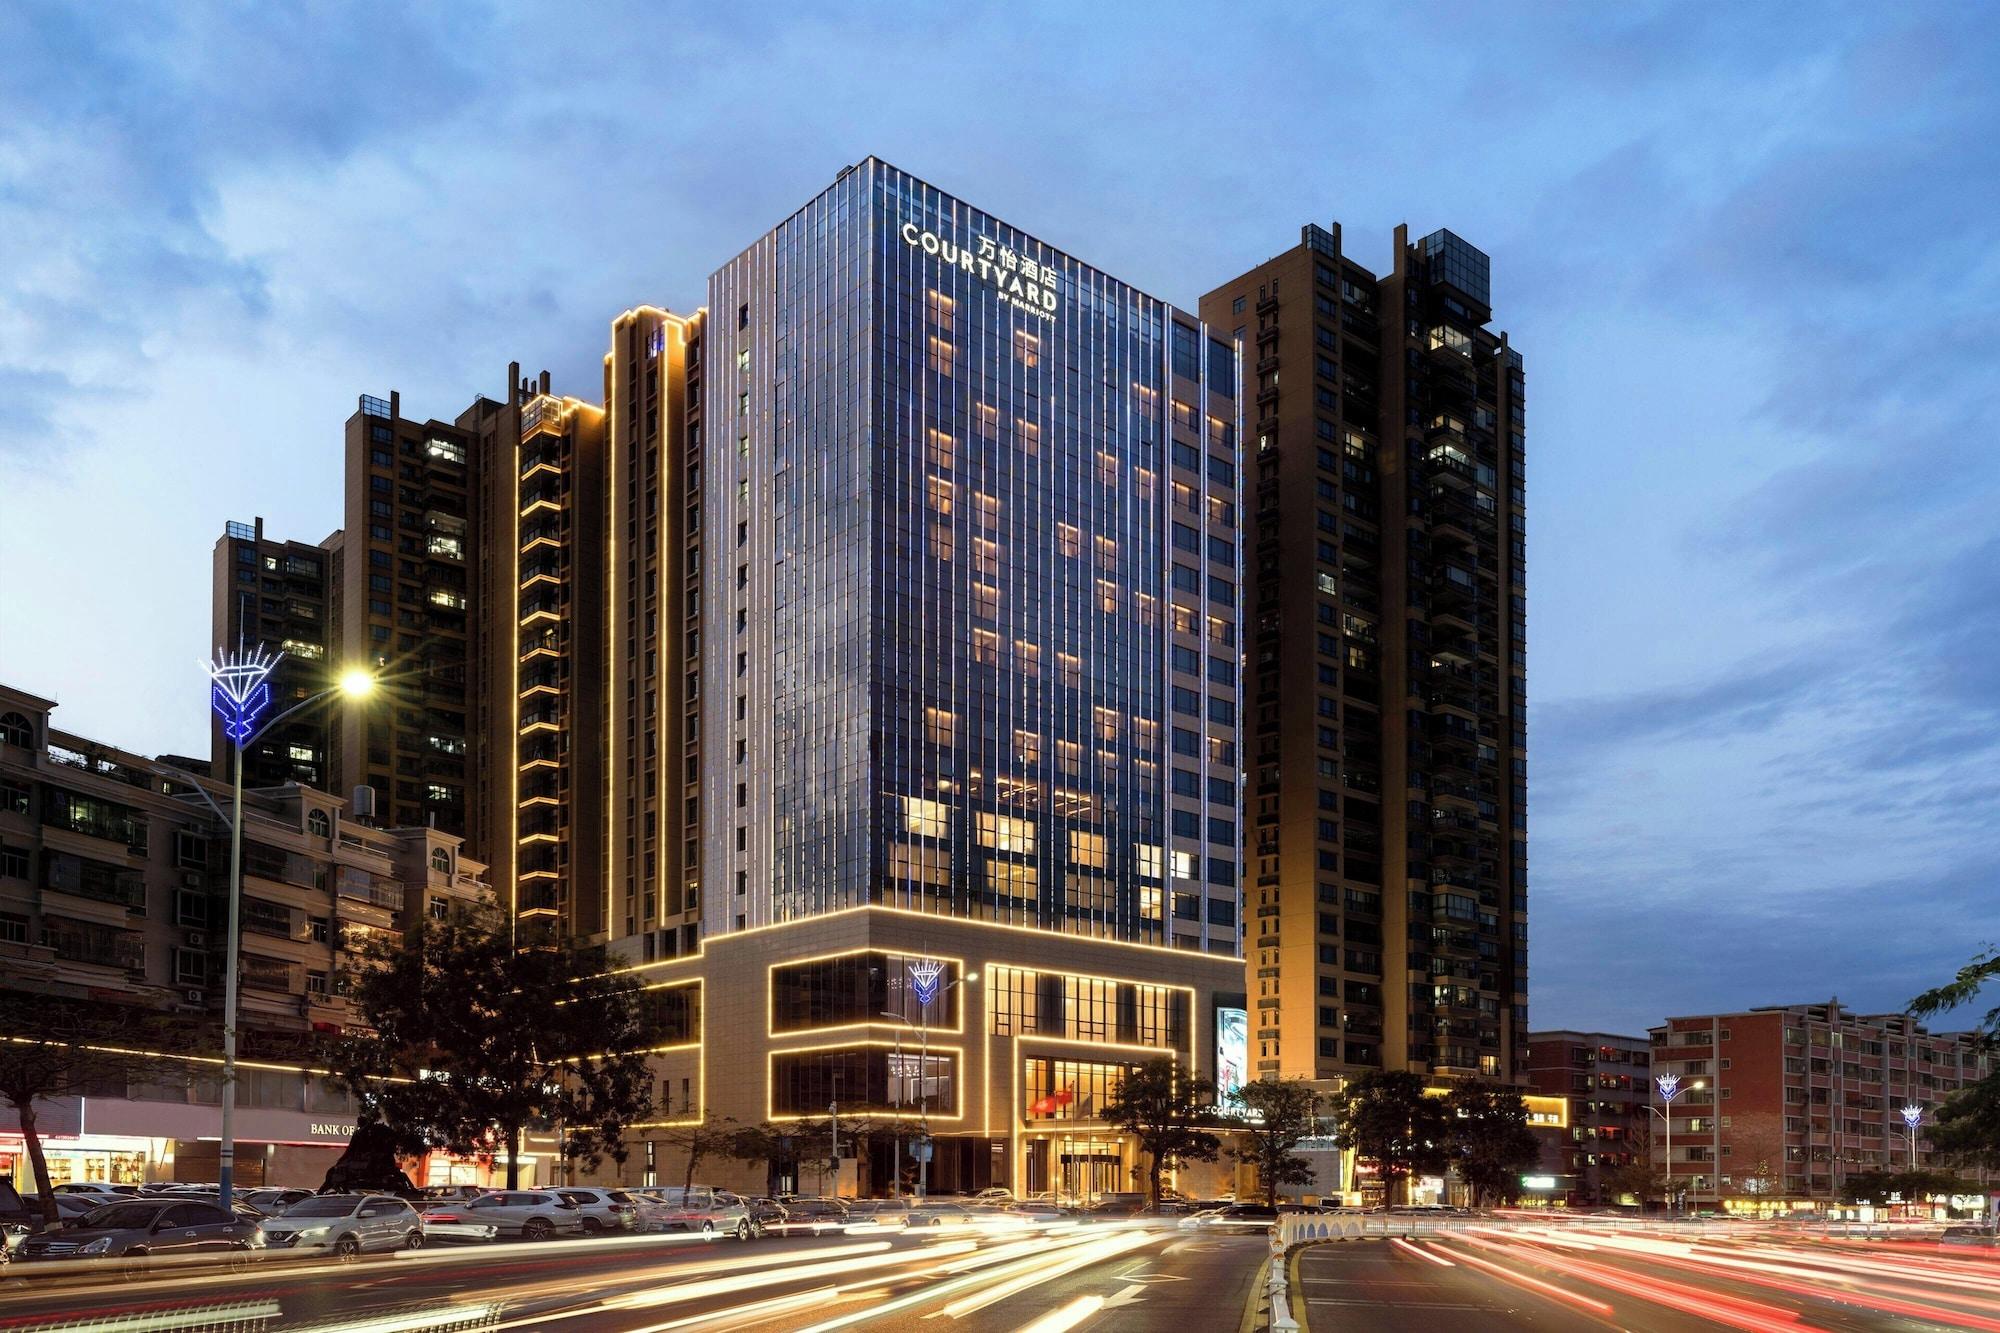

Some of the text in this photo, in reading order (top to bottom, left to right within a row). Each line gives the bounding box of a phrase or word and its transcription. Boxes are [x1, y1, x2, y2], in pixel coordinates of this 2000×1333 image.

[902, 223, 1057, 311] COURTYARD
[978, 235, 1057, 290] 万怡酒店
[998, 291, 1057, 321] BY MARRIOTT
[311, 1124, 339, 1135] BANK
